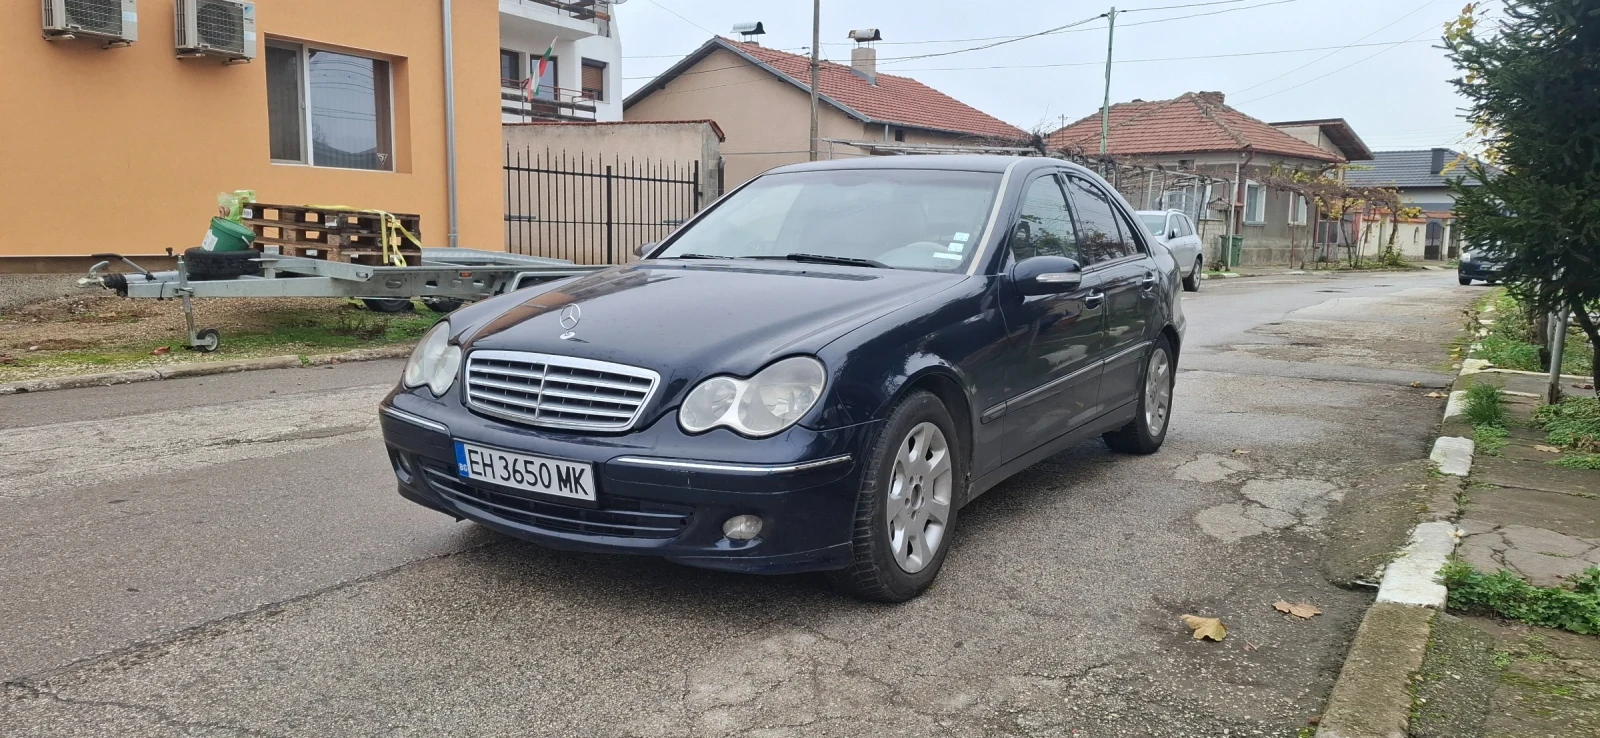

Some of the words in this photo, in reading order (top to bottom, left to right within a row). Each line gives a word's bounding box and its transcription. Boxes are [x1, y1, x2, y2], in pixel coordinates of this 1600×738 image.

[459, 463, 468, 472] BG
[468, 449, 496, 479] EH
[499, 456, 551, 489] 3650
[556, 464, 588, 495] MK
